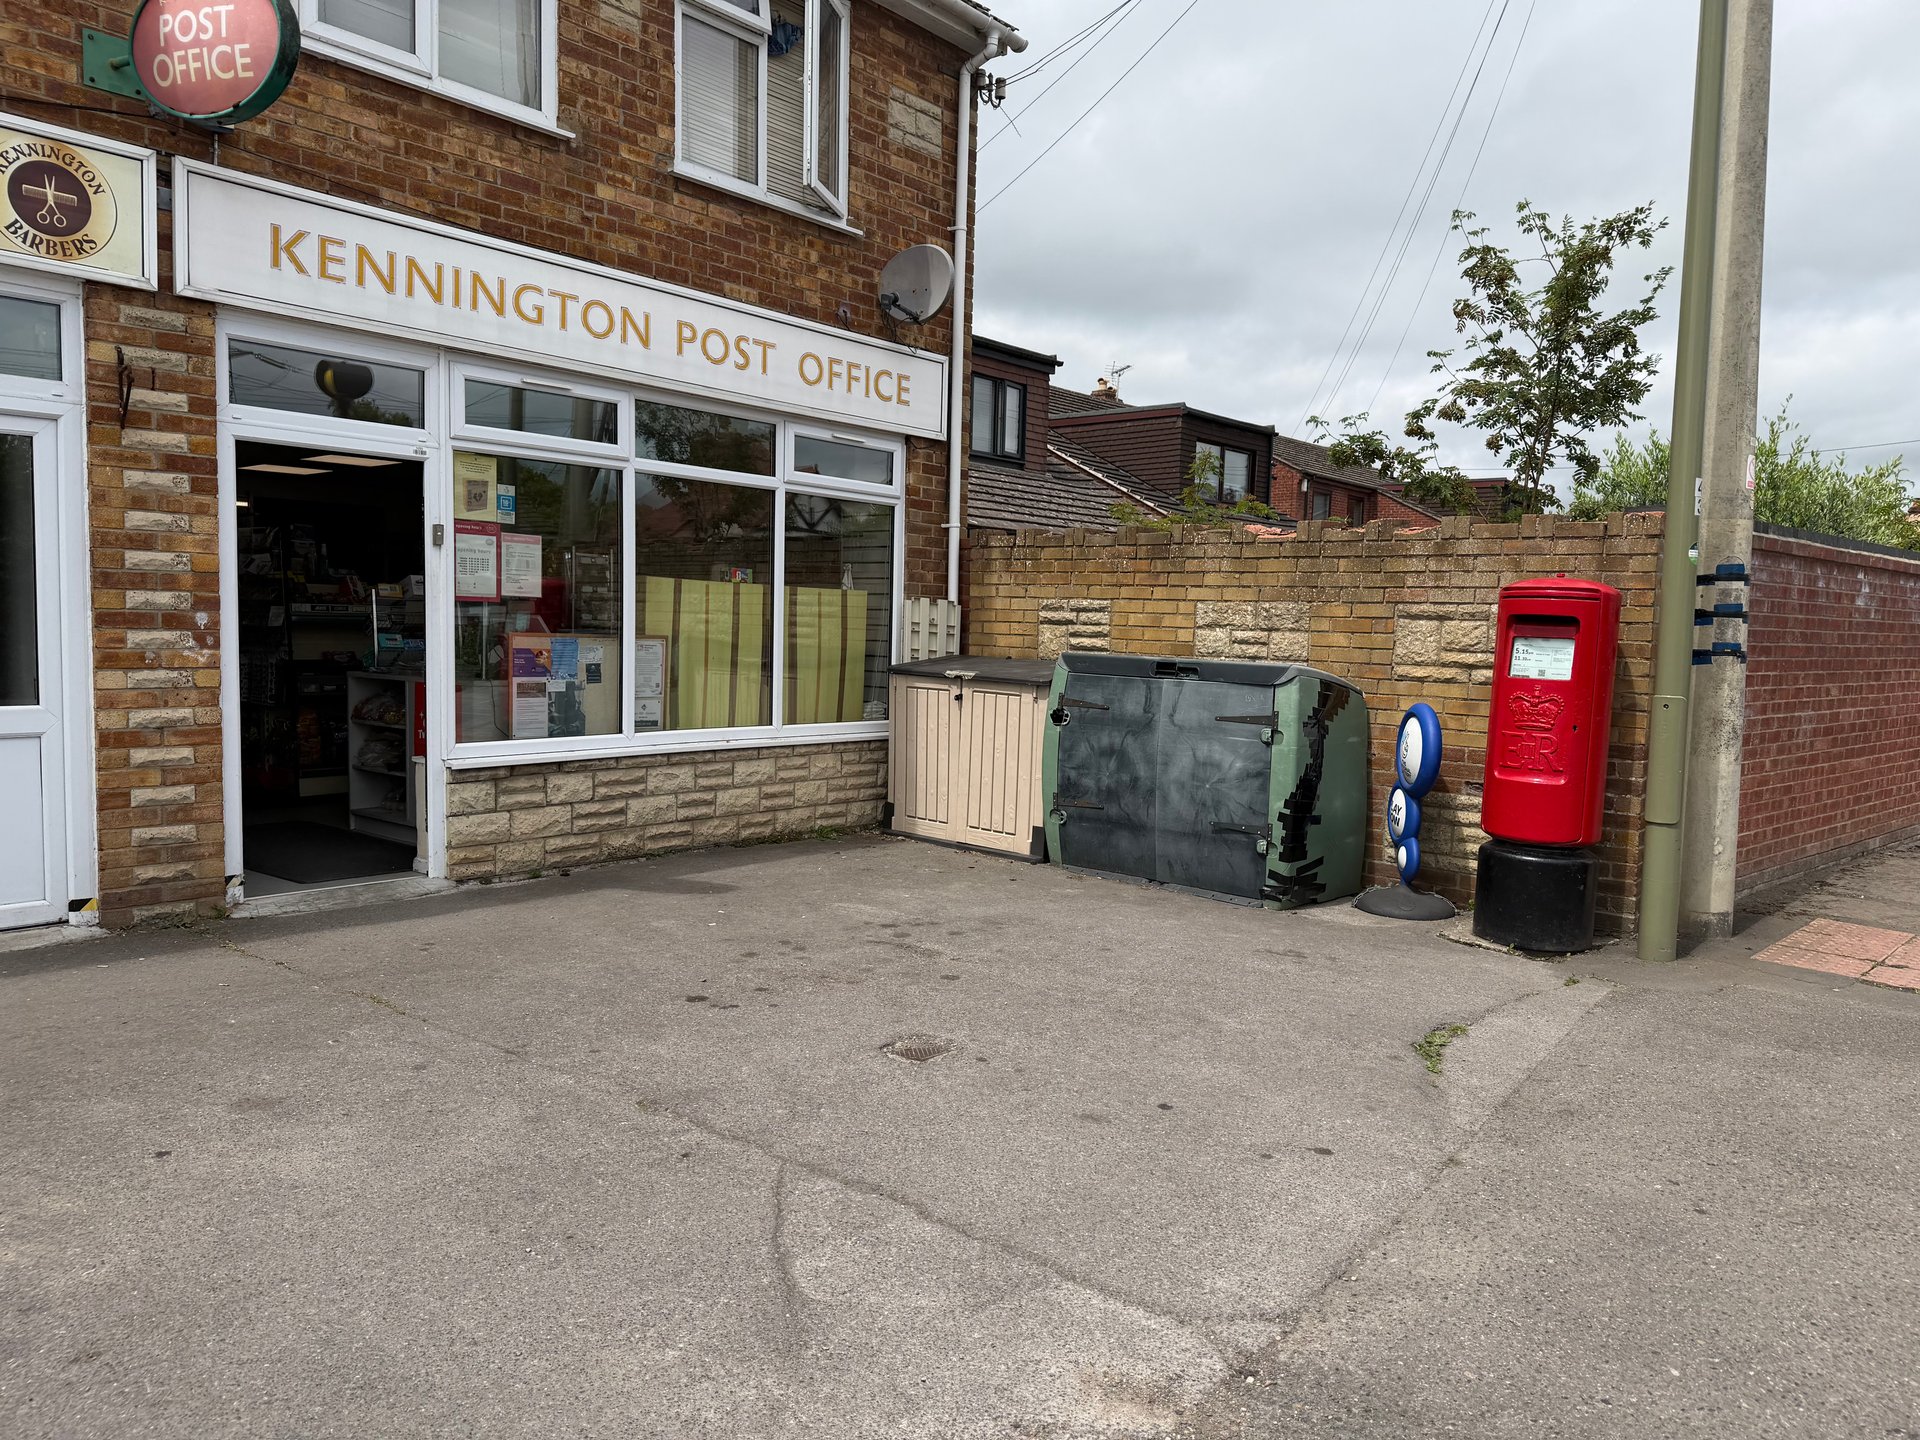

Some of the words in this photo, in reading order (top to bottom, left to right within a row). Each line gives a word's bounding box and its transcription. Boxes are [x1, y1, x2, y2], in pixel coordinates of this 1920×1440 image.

[159, 4, 235, 47] POST
[152, 43, 255, 87] OFFICE
[3, 217, 98, 257] BARBERS
[269, 222, 652, 351] KENNINGTON
[676, 319, 777, 376] POST
[797, 351, 912, 407] OFFICE
